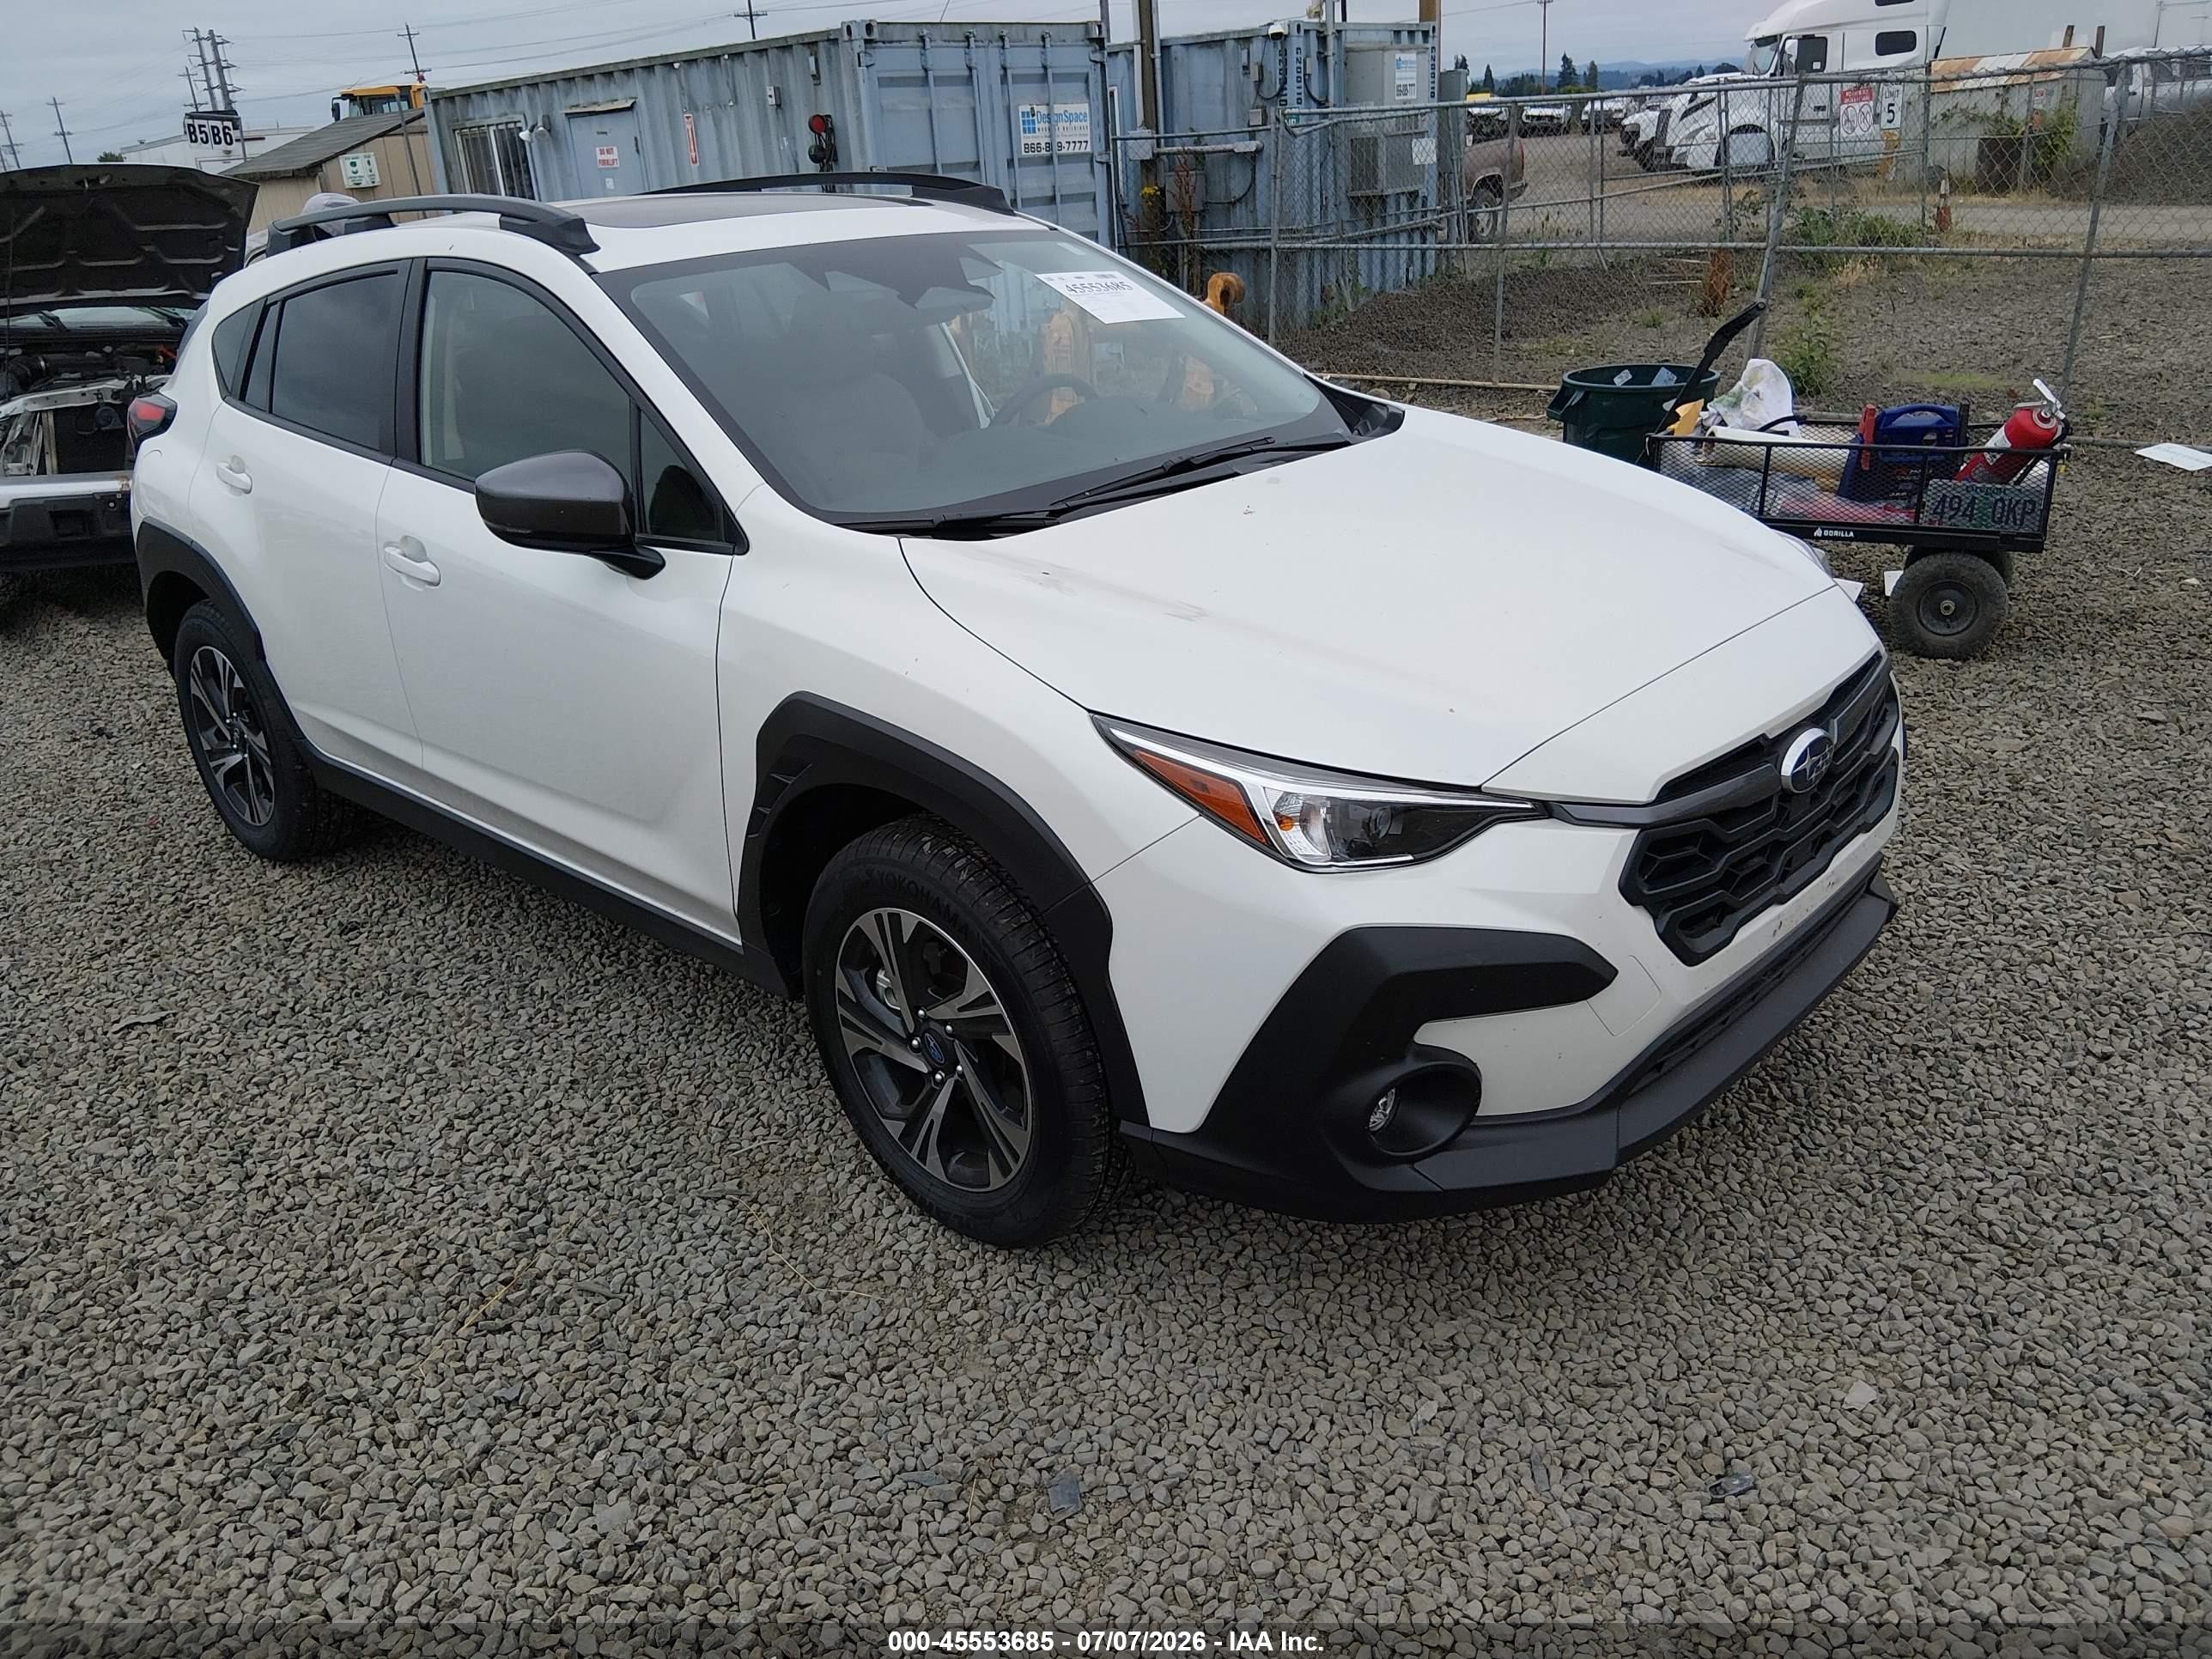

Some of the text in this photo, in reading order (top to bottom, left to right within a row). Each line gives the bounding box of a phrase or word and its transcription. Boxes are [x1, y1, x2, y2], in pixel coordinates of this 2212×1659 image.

[1887, 103, 1895, 124] 5
[1065, 281, 1133, 294] 45553685
[1932, 493, 1977, 523] 494
[1823, 529, 1855, 538] GORILLA
